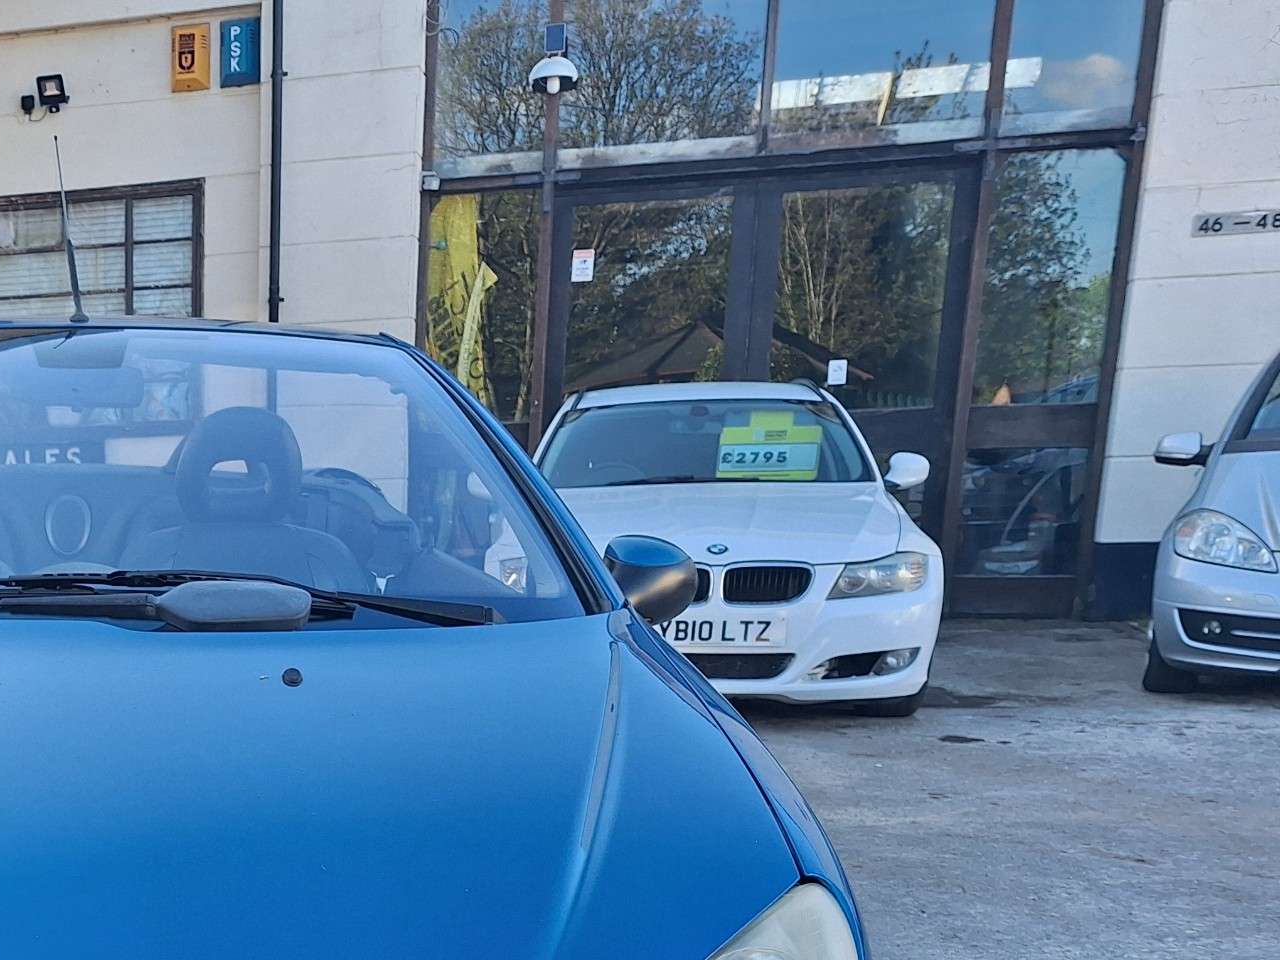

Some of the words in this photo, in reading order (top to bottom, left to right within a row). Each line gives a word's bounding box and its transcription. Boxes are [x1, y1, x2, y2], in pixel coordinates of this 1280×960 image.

[230, 25, 241, 73] PSK
[1198, 217, 1223, 234] 46
[721, 451, 788, 464] £2795
[721, 620, 772, 642] LTZ
